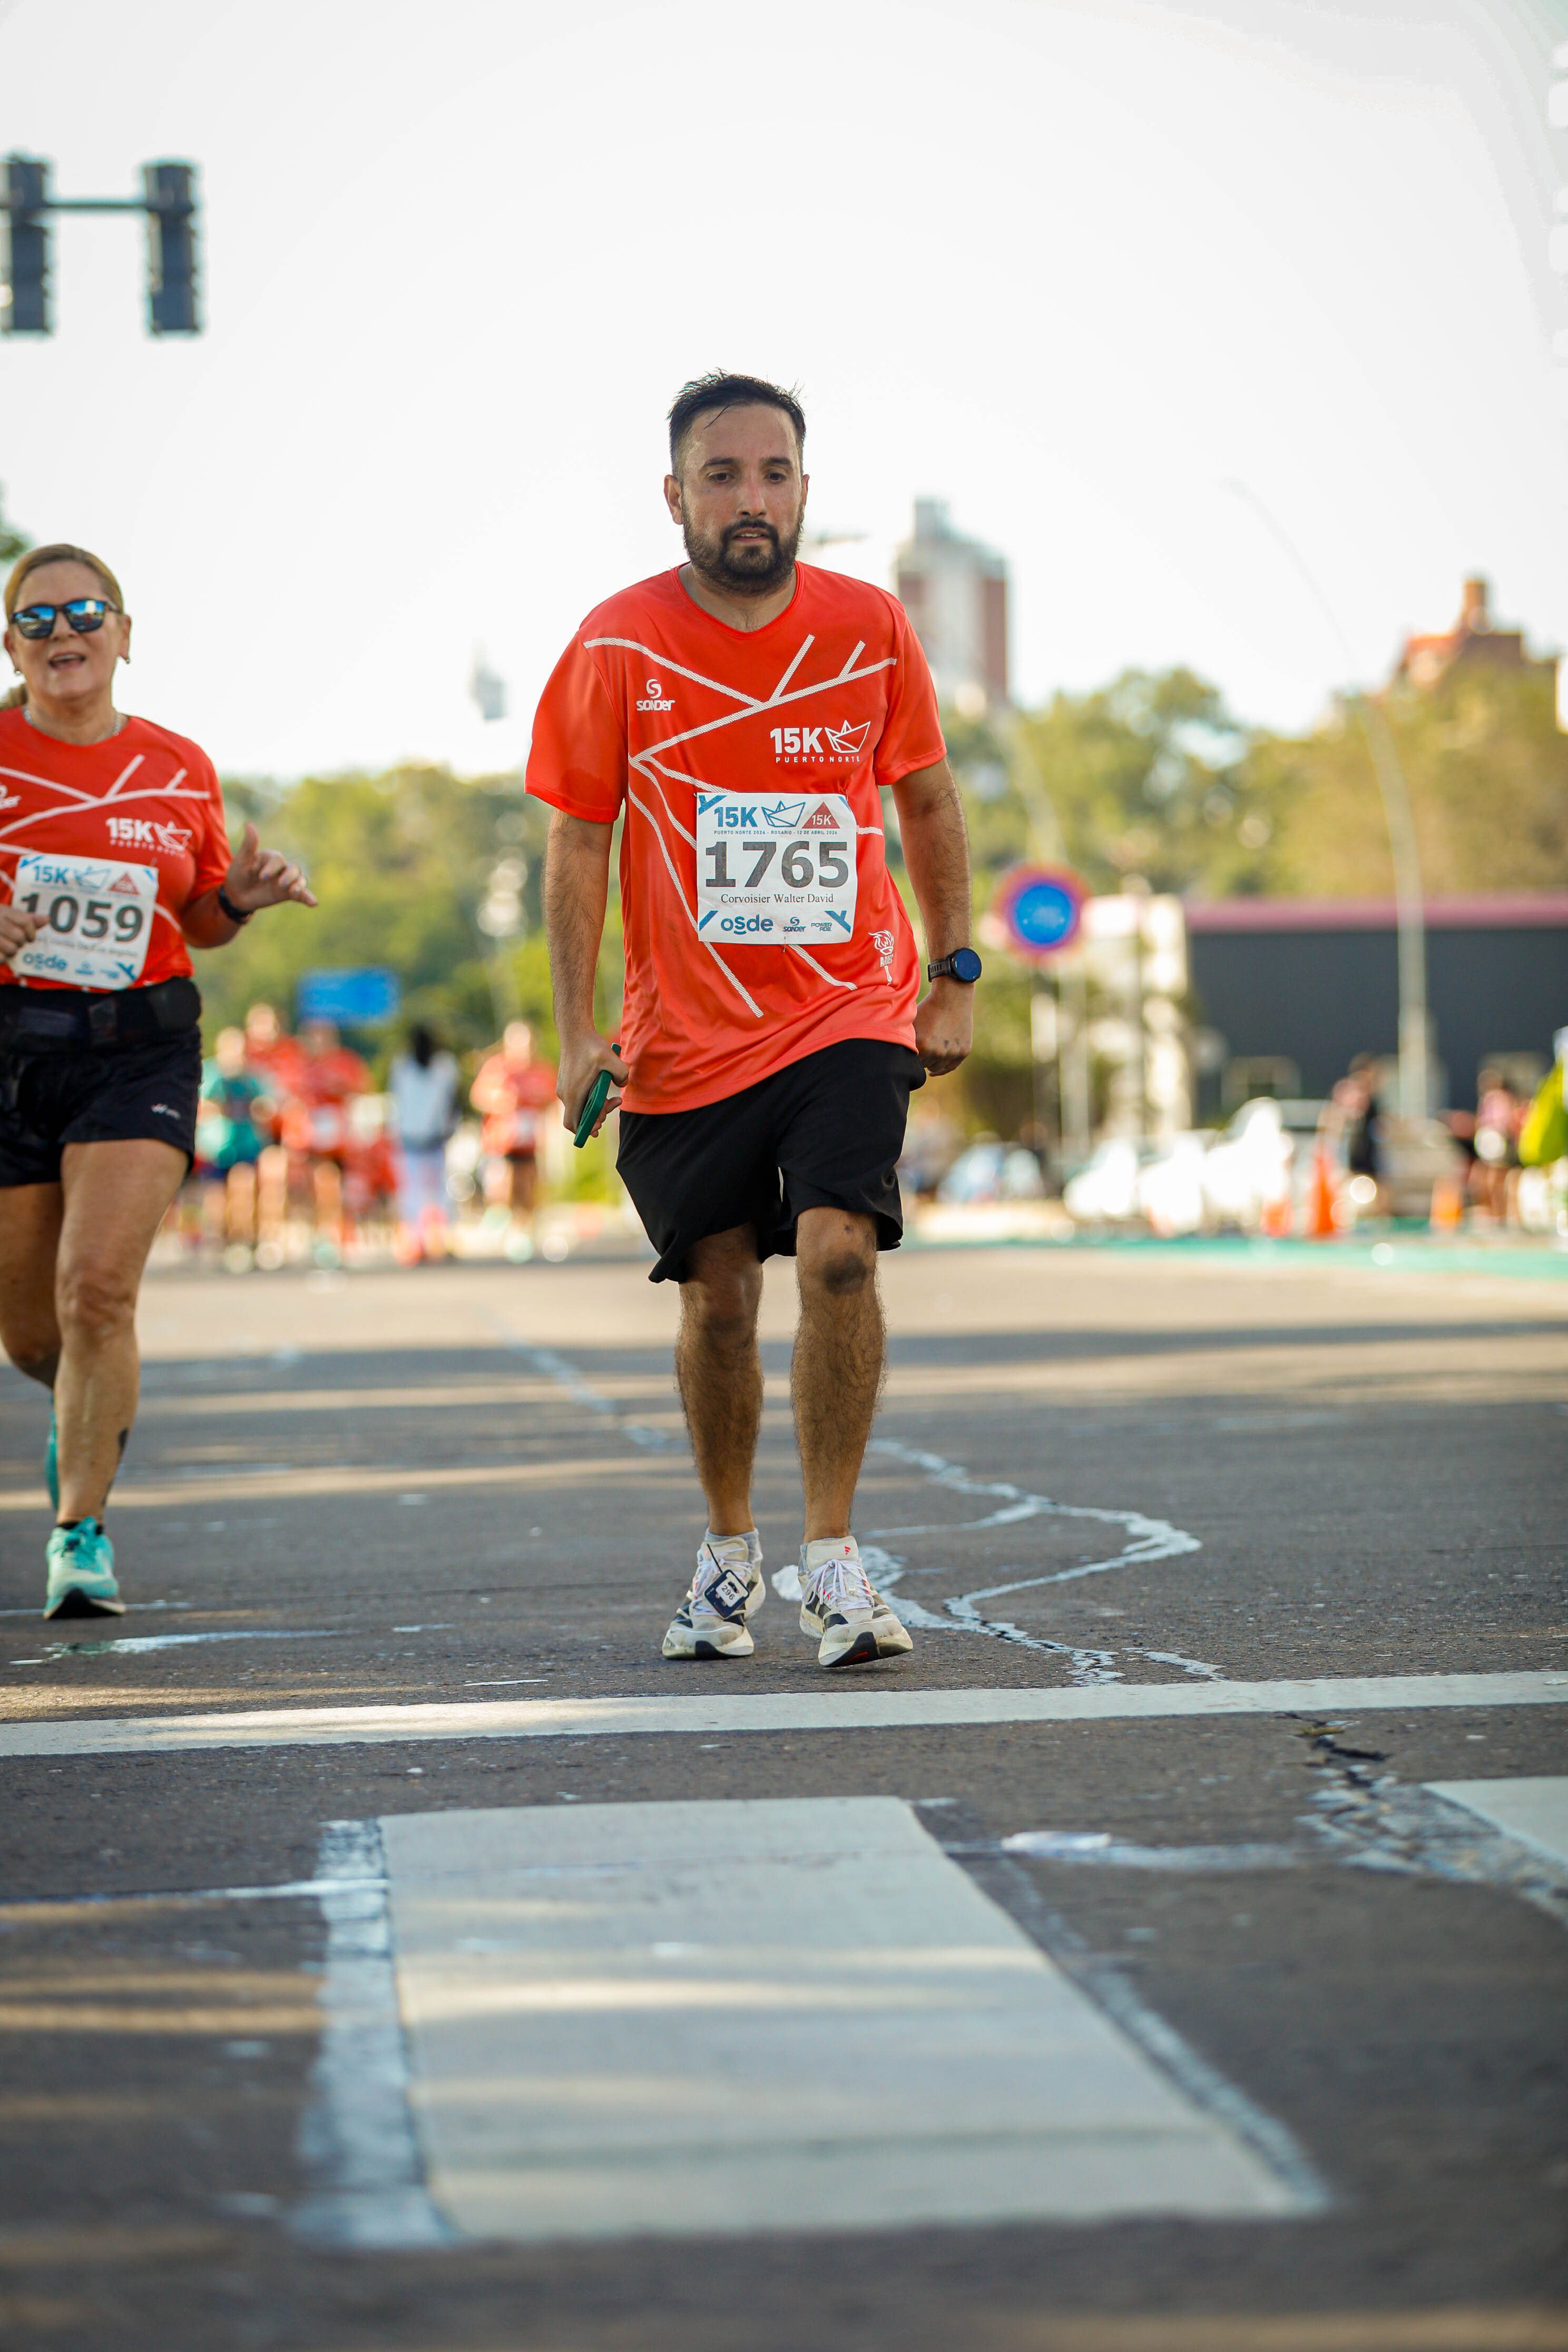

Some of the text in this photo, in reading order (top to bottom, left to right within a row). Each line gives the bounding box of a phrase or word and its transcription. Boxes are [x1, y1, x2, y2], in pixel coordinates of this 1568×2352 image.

[770, 727, 824, 753] 15K
[714, 807, 758, 828] 15K
[811, 815, 832, 826] 15K
[105, 817, 155, 843] 15K
[705, 840, 849, 888] 1765
[33, 865, 70, 885] 15K
[721, 893, 834, 903] Corvoisier Walter David
[720, 914, 773, 933] osde
[23, 953, 67, 970] osde
[721, 1585, 735, 1600] 296
